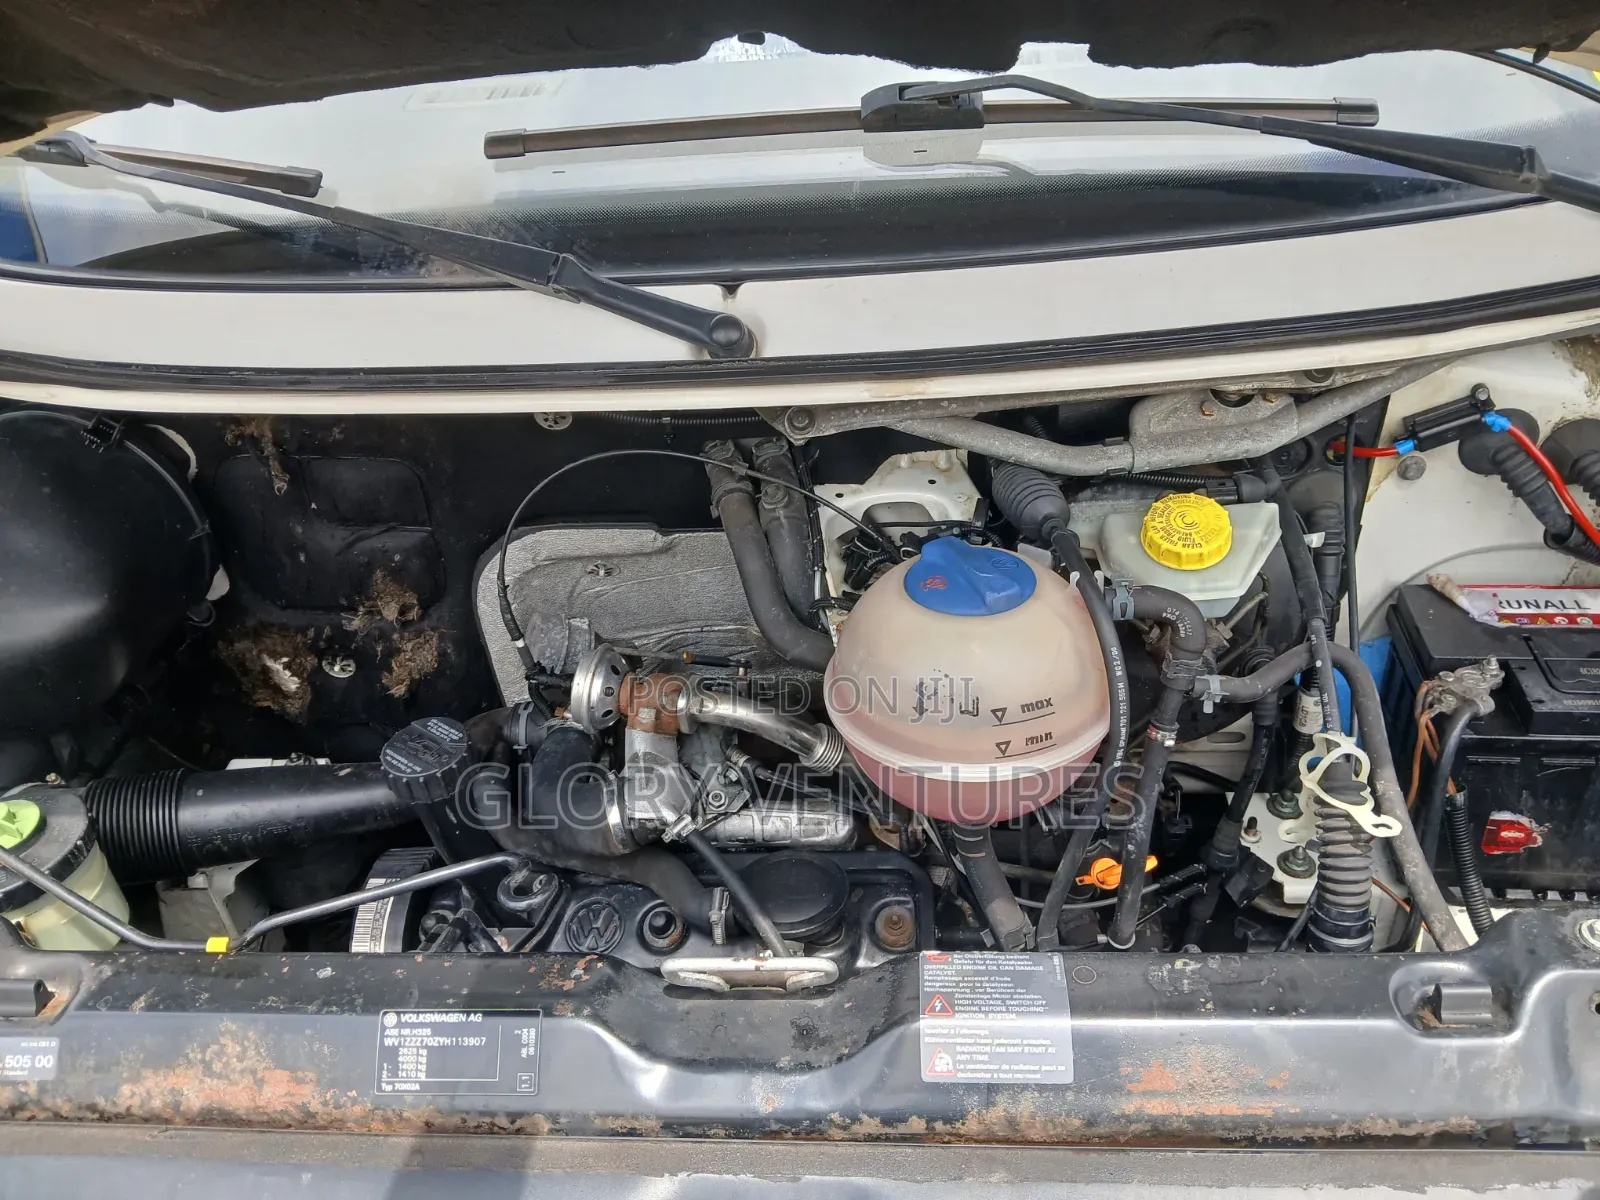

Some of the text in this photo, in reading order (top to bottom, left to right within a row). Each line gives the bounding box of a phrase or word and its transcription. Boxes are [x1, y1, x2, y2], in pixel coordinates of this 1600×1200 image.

[1020, 697, 1053, 714] max
[1025, 732, 1053, 746] min
[400, 1013, 466, 1023] VOLKSWAGEN
[468, 1013, 482, 1022] AG
[384, 1037, 486, 1047] WV1ZZZ70ZYH113907
[419, 1048, 427, 1056] kg
[5, 1055, 32, 1068] 505
[35, 1055, 53, 1068] 00
[418, 1055, 426, 1064] kg
[418, 1063, 426, 1072] kg
[381, 1083, 393, 1092] Typ
